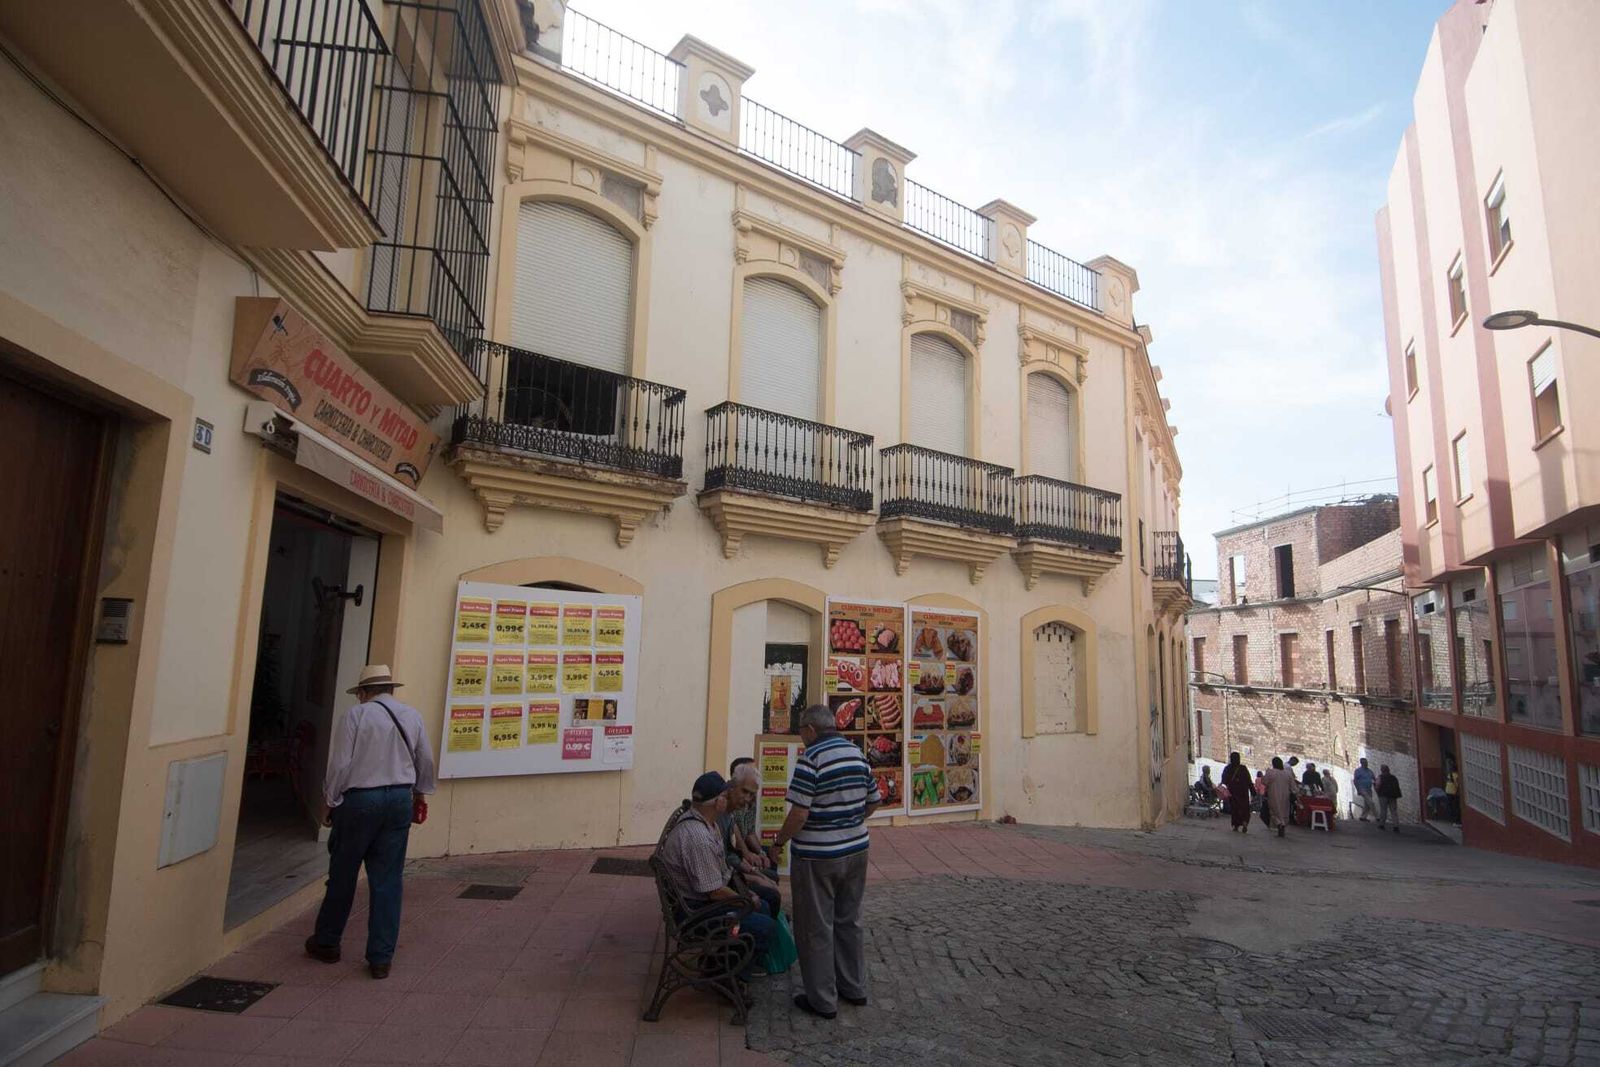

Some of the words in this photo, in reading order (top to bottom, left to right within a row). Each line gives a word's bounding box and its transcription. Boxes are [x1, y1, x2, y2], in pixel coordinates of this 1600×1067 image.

[303, 349, 372, 416] CUARTO
[370, 404, 381, 423] Y
[378, 408, 418, 450] MITAD
[350, 424, 361, 441] &
[496, 624, 525, 633] 0,99€
